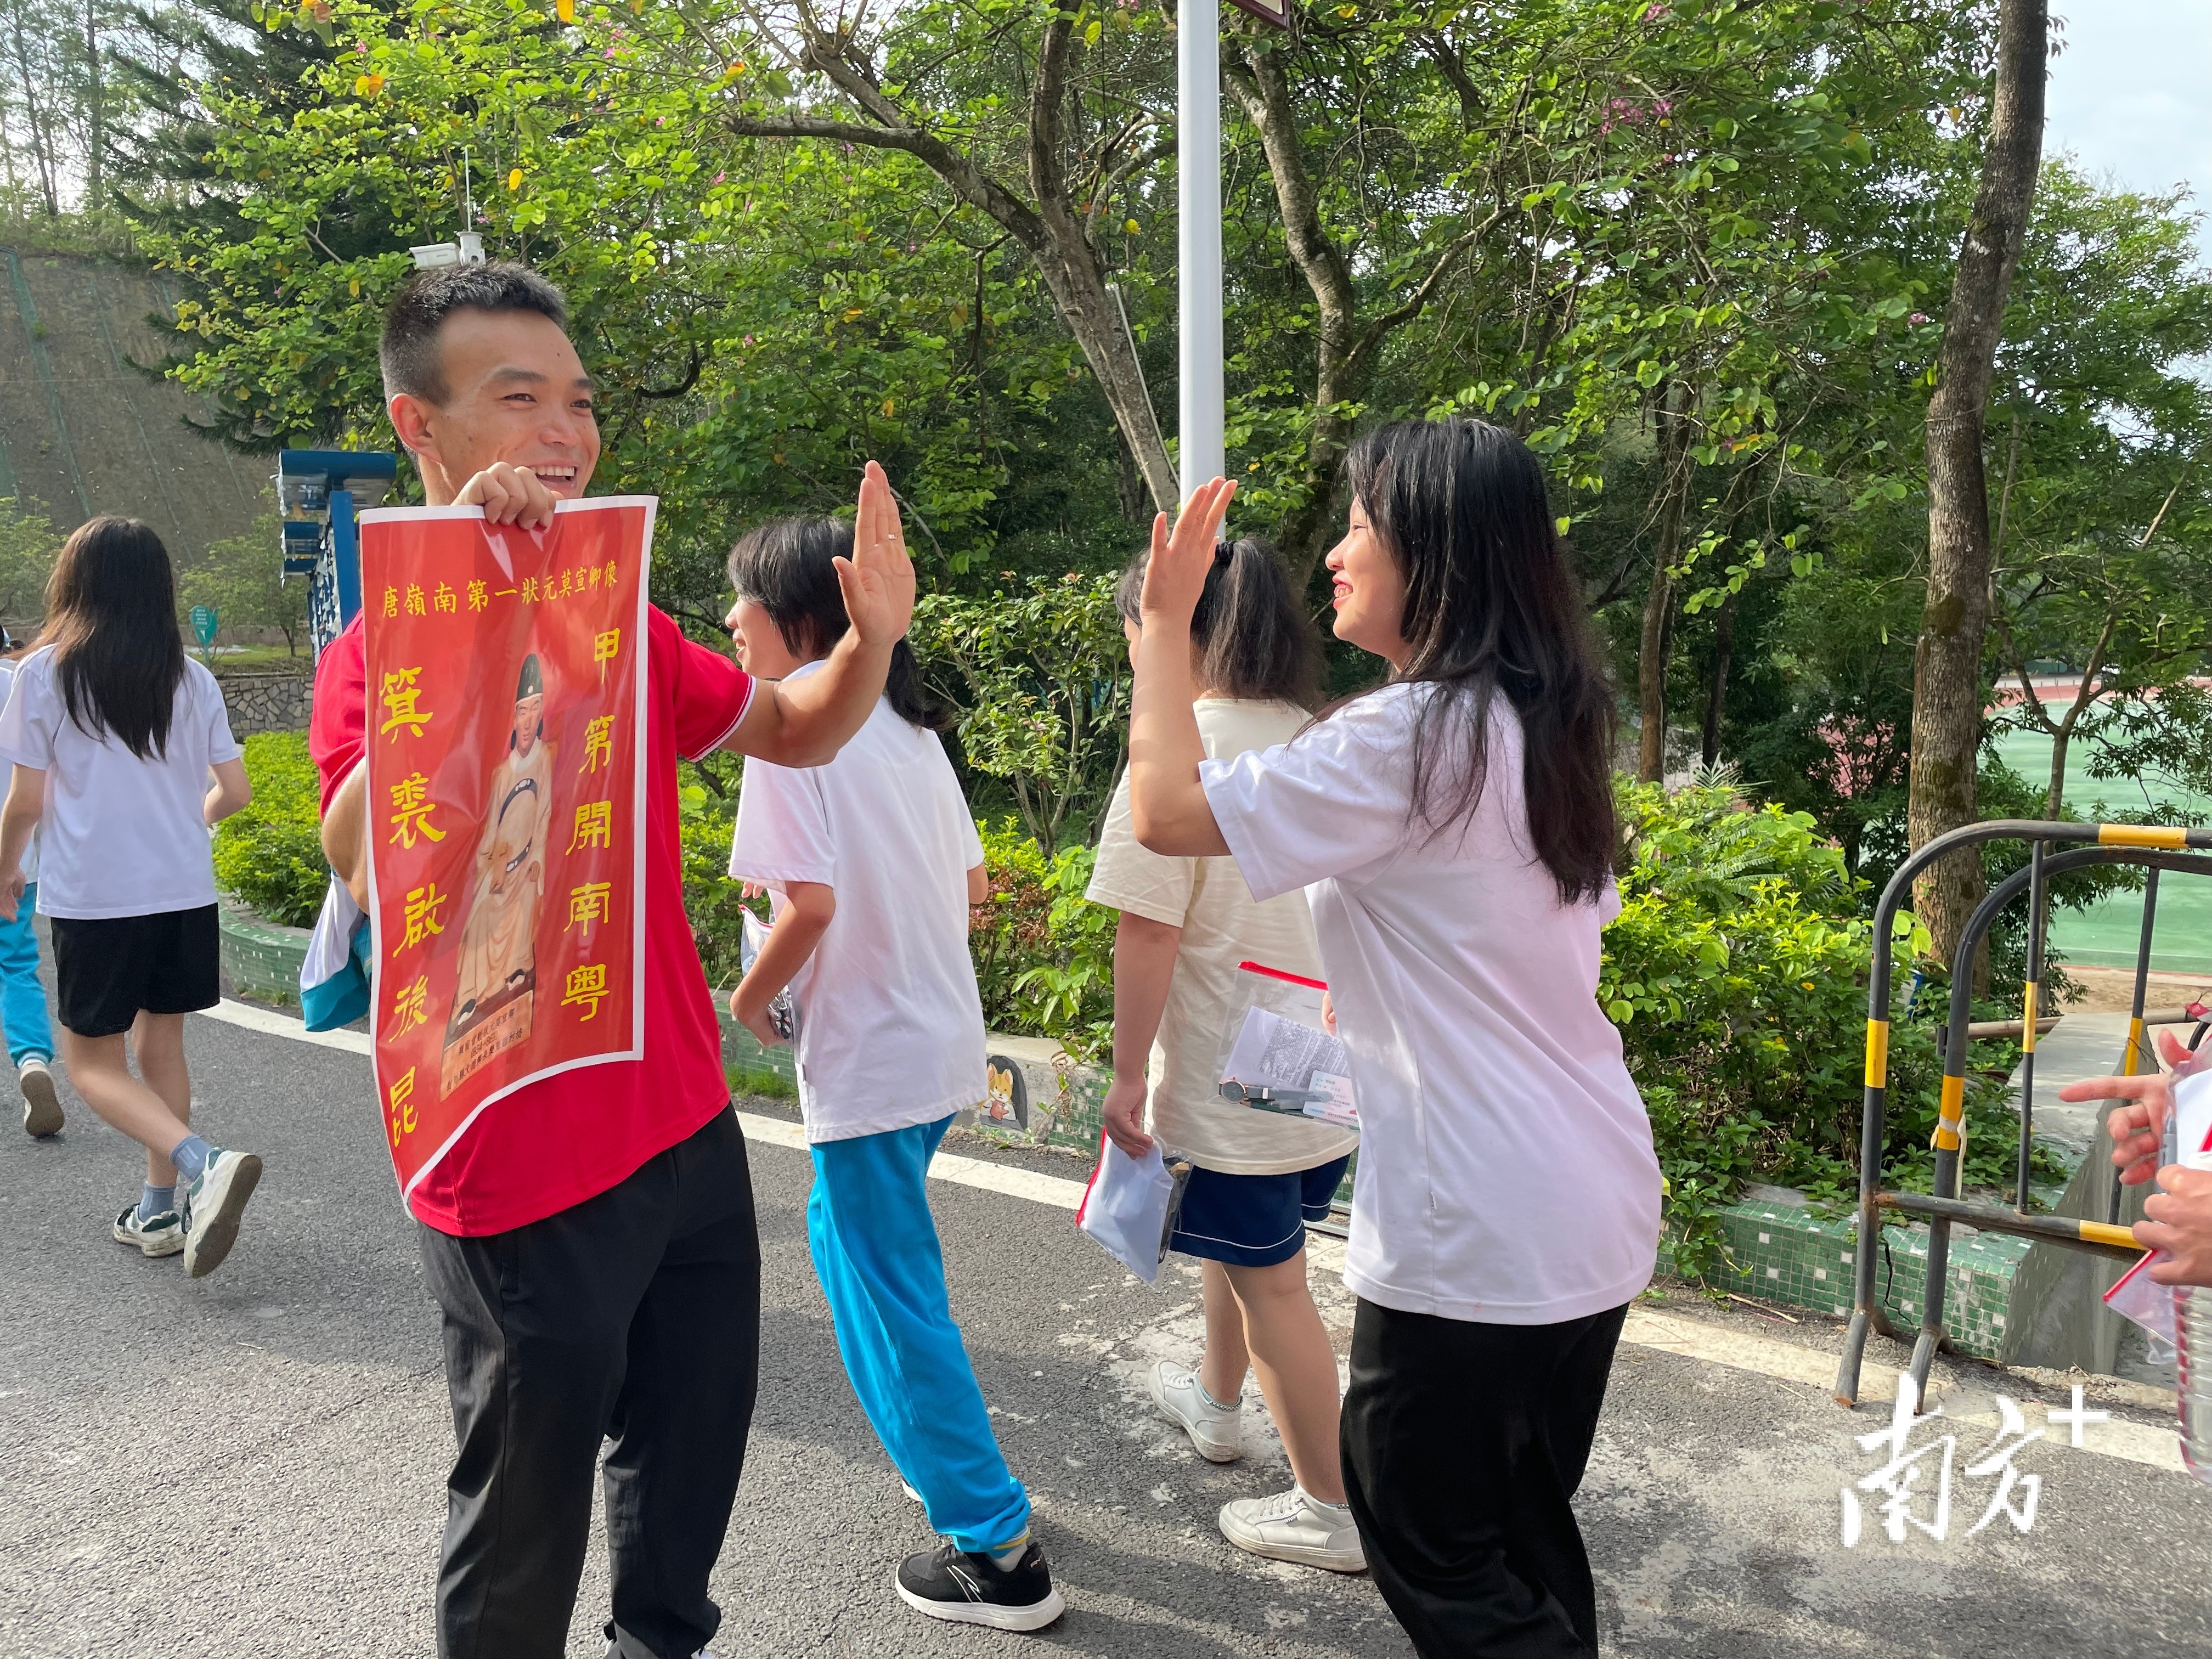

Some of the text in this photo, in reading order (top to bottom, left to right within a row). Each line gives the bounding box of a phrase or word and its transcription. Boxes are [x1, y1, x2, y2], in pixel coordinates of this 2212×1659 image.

[382, 560, 618, 618] 唐嶺南第一狀元莫宣卿像
